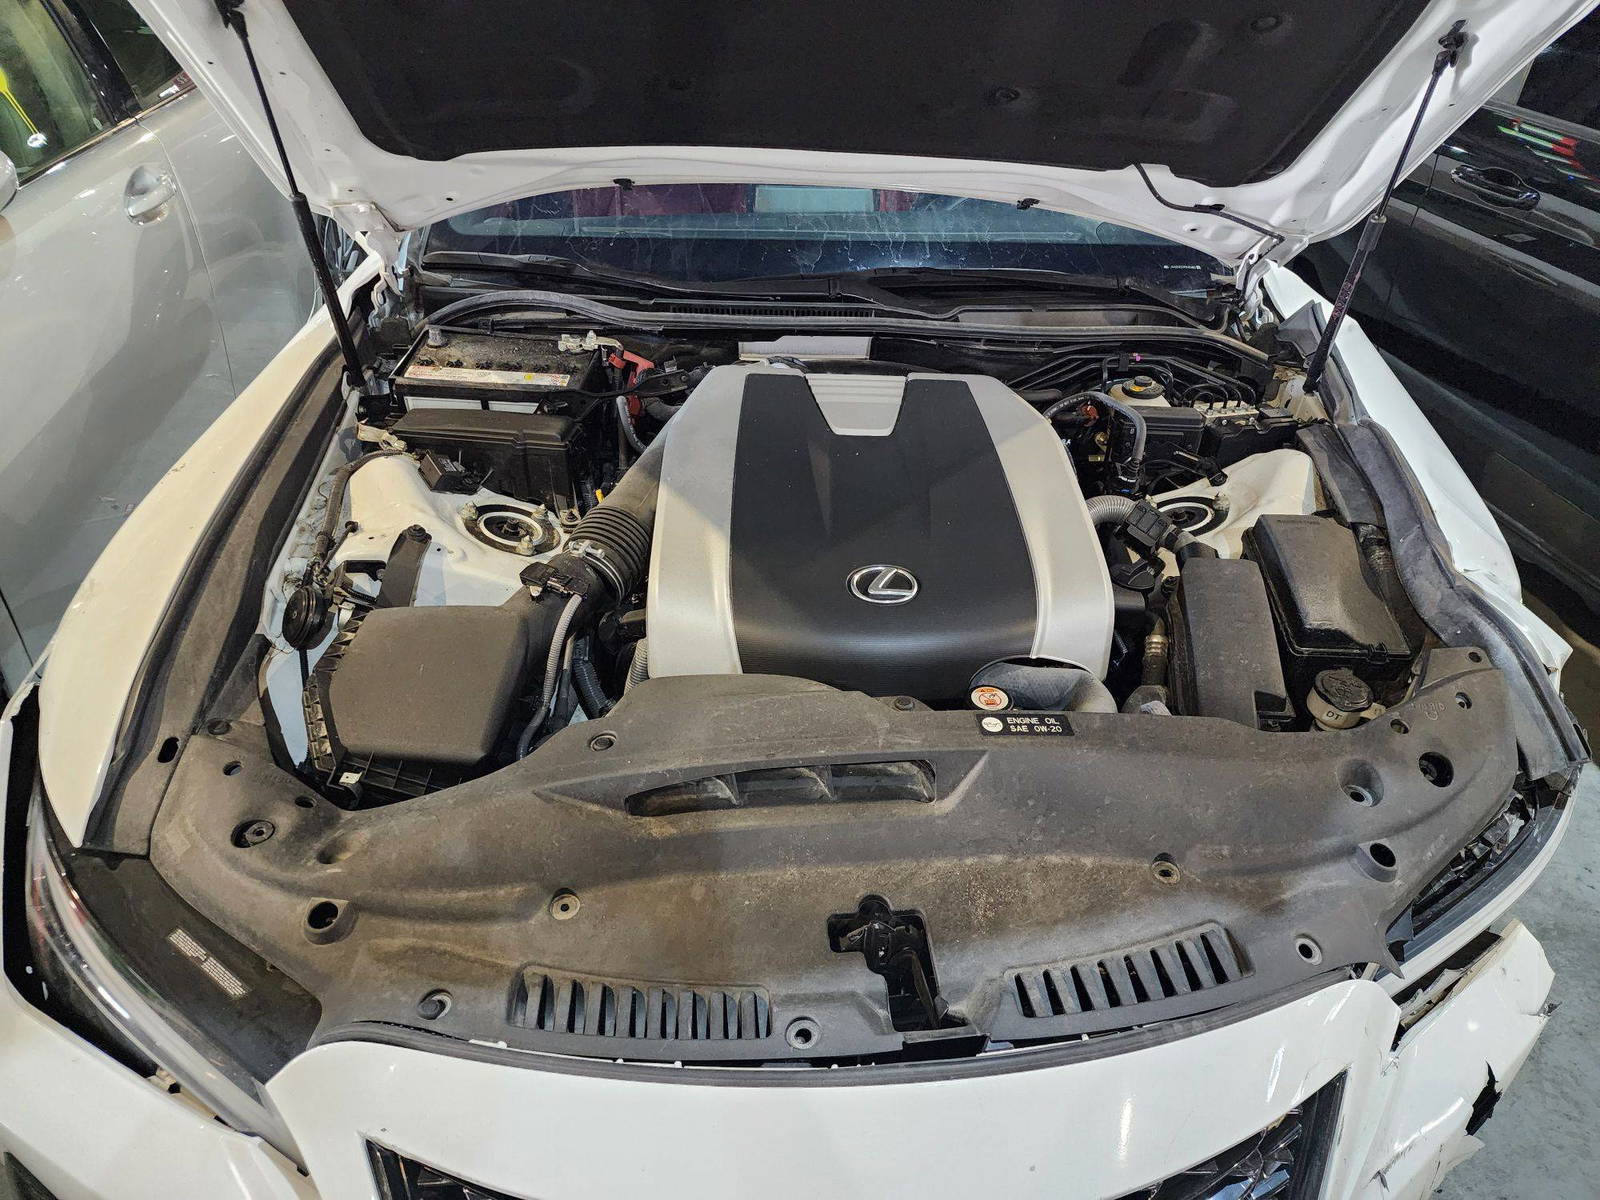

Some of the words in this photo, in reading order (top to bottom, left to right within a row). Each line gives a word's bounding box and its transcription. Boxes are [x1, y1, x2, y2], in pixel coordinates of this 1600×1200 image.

[1006, 717, 1040, 725] ENGINE
[1045, 717, 1060, 725] OIL
[1010, 725, 1029, 733] SAE
